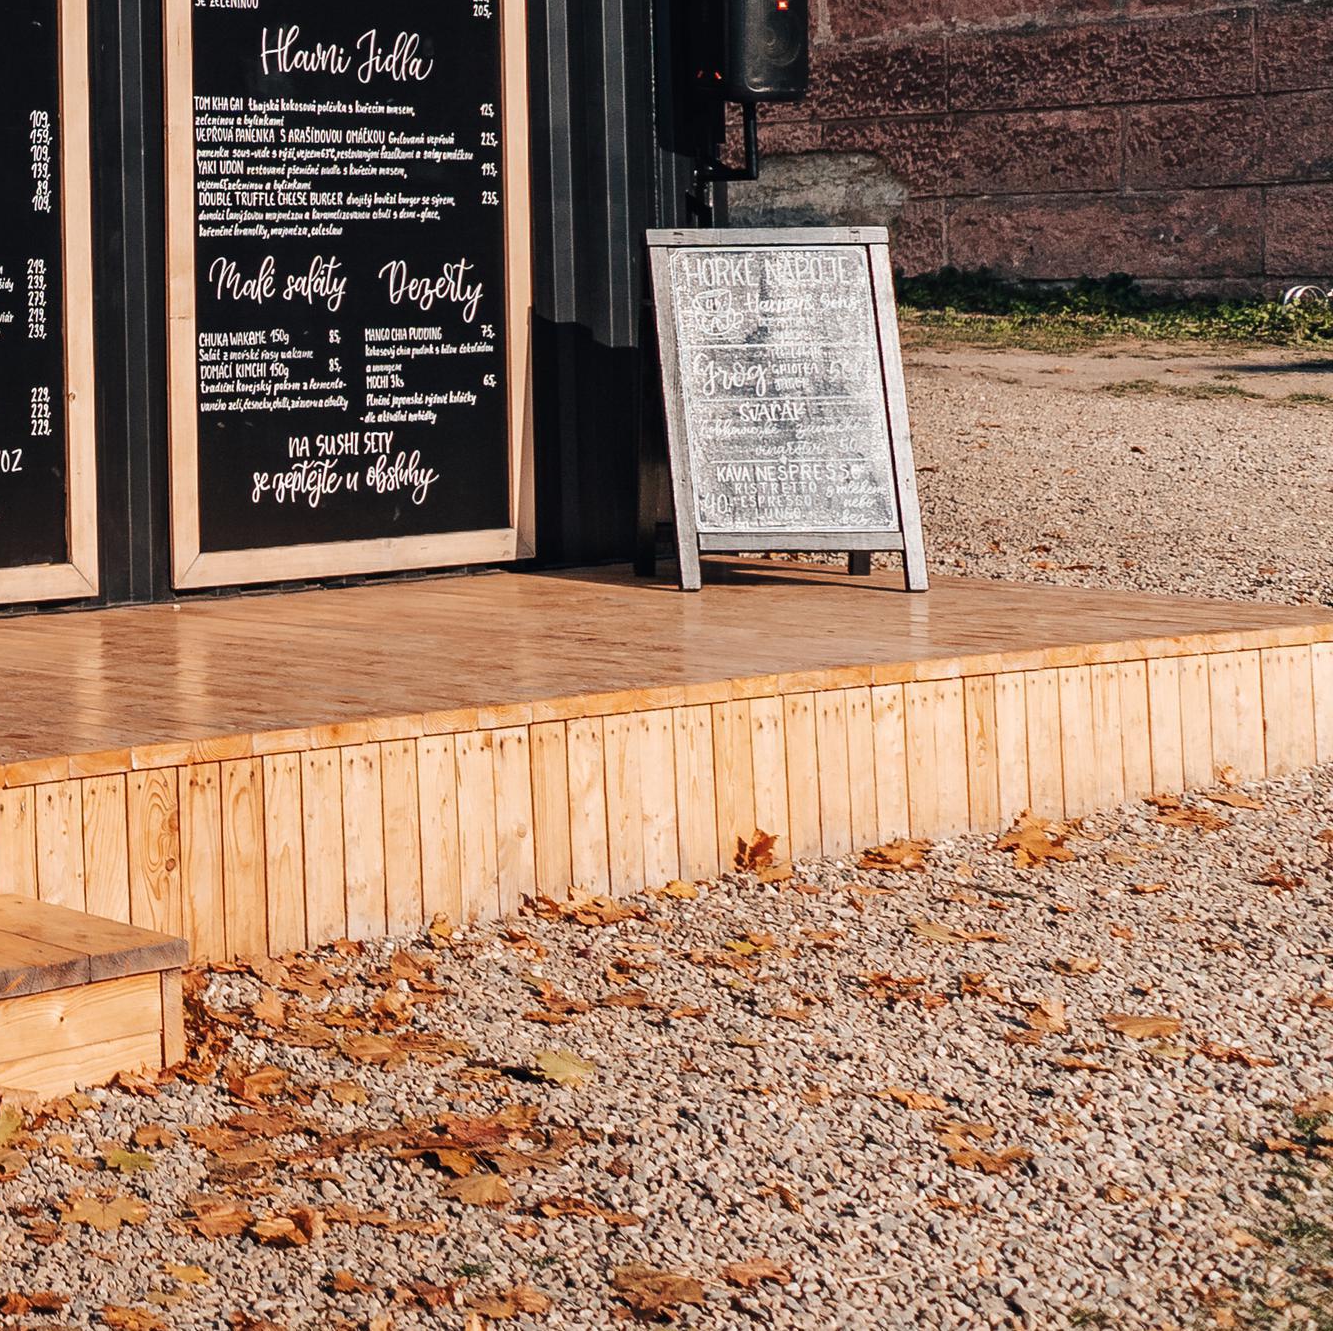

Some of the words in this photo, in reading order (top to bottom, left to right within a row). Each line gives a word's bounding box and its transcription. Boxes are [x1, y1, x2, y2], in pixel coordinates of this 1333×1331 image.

[194, 96, 212, 112] TOM
[212, 96, 229, 112] KHA
[235, 128, 276, 144] PANENKA
[197, 159, 218, 175] YAKI
[219, 159, 245, 176] UDON
[199, 191, 233, 207] DOUBLE
[234, 191, 276, 207] TRUFFLE
[277, 191, 309, 207] CHEESE
[309, 191, 344, 207] BURGER
[209, 255, 277, 305] Malé
[282, 254, 348, 312] saláty
[378, 258, 484, 324] Dezerty
[198, 331, 229, 348] CHUKA
[229, 330, 268, 347] WAKAME
[269, 328, 290, 346] 150g
[235, 362, 268, 379] KIMCHI
[269, 361, 290, 380] 150g
[365, 374, 390, 390] MOCHI
[289, 435, 311, 458] NA
[315, 431, 359, 457] SUSHI
[363, 431, 395, 454] SETY
[252, 471, 271, 504] se
[345, 470, 360, 492] u
[365, 450, 440, 506] obsluhy
